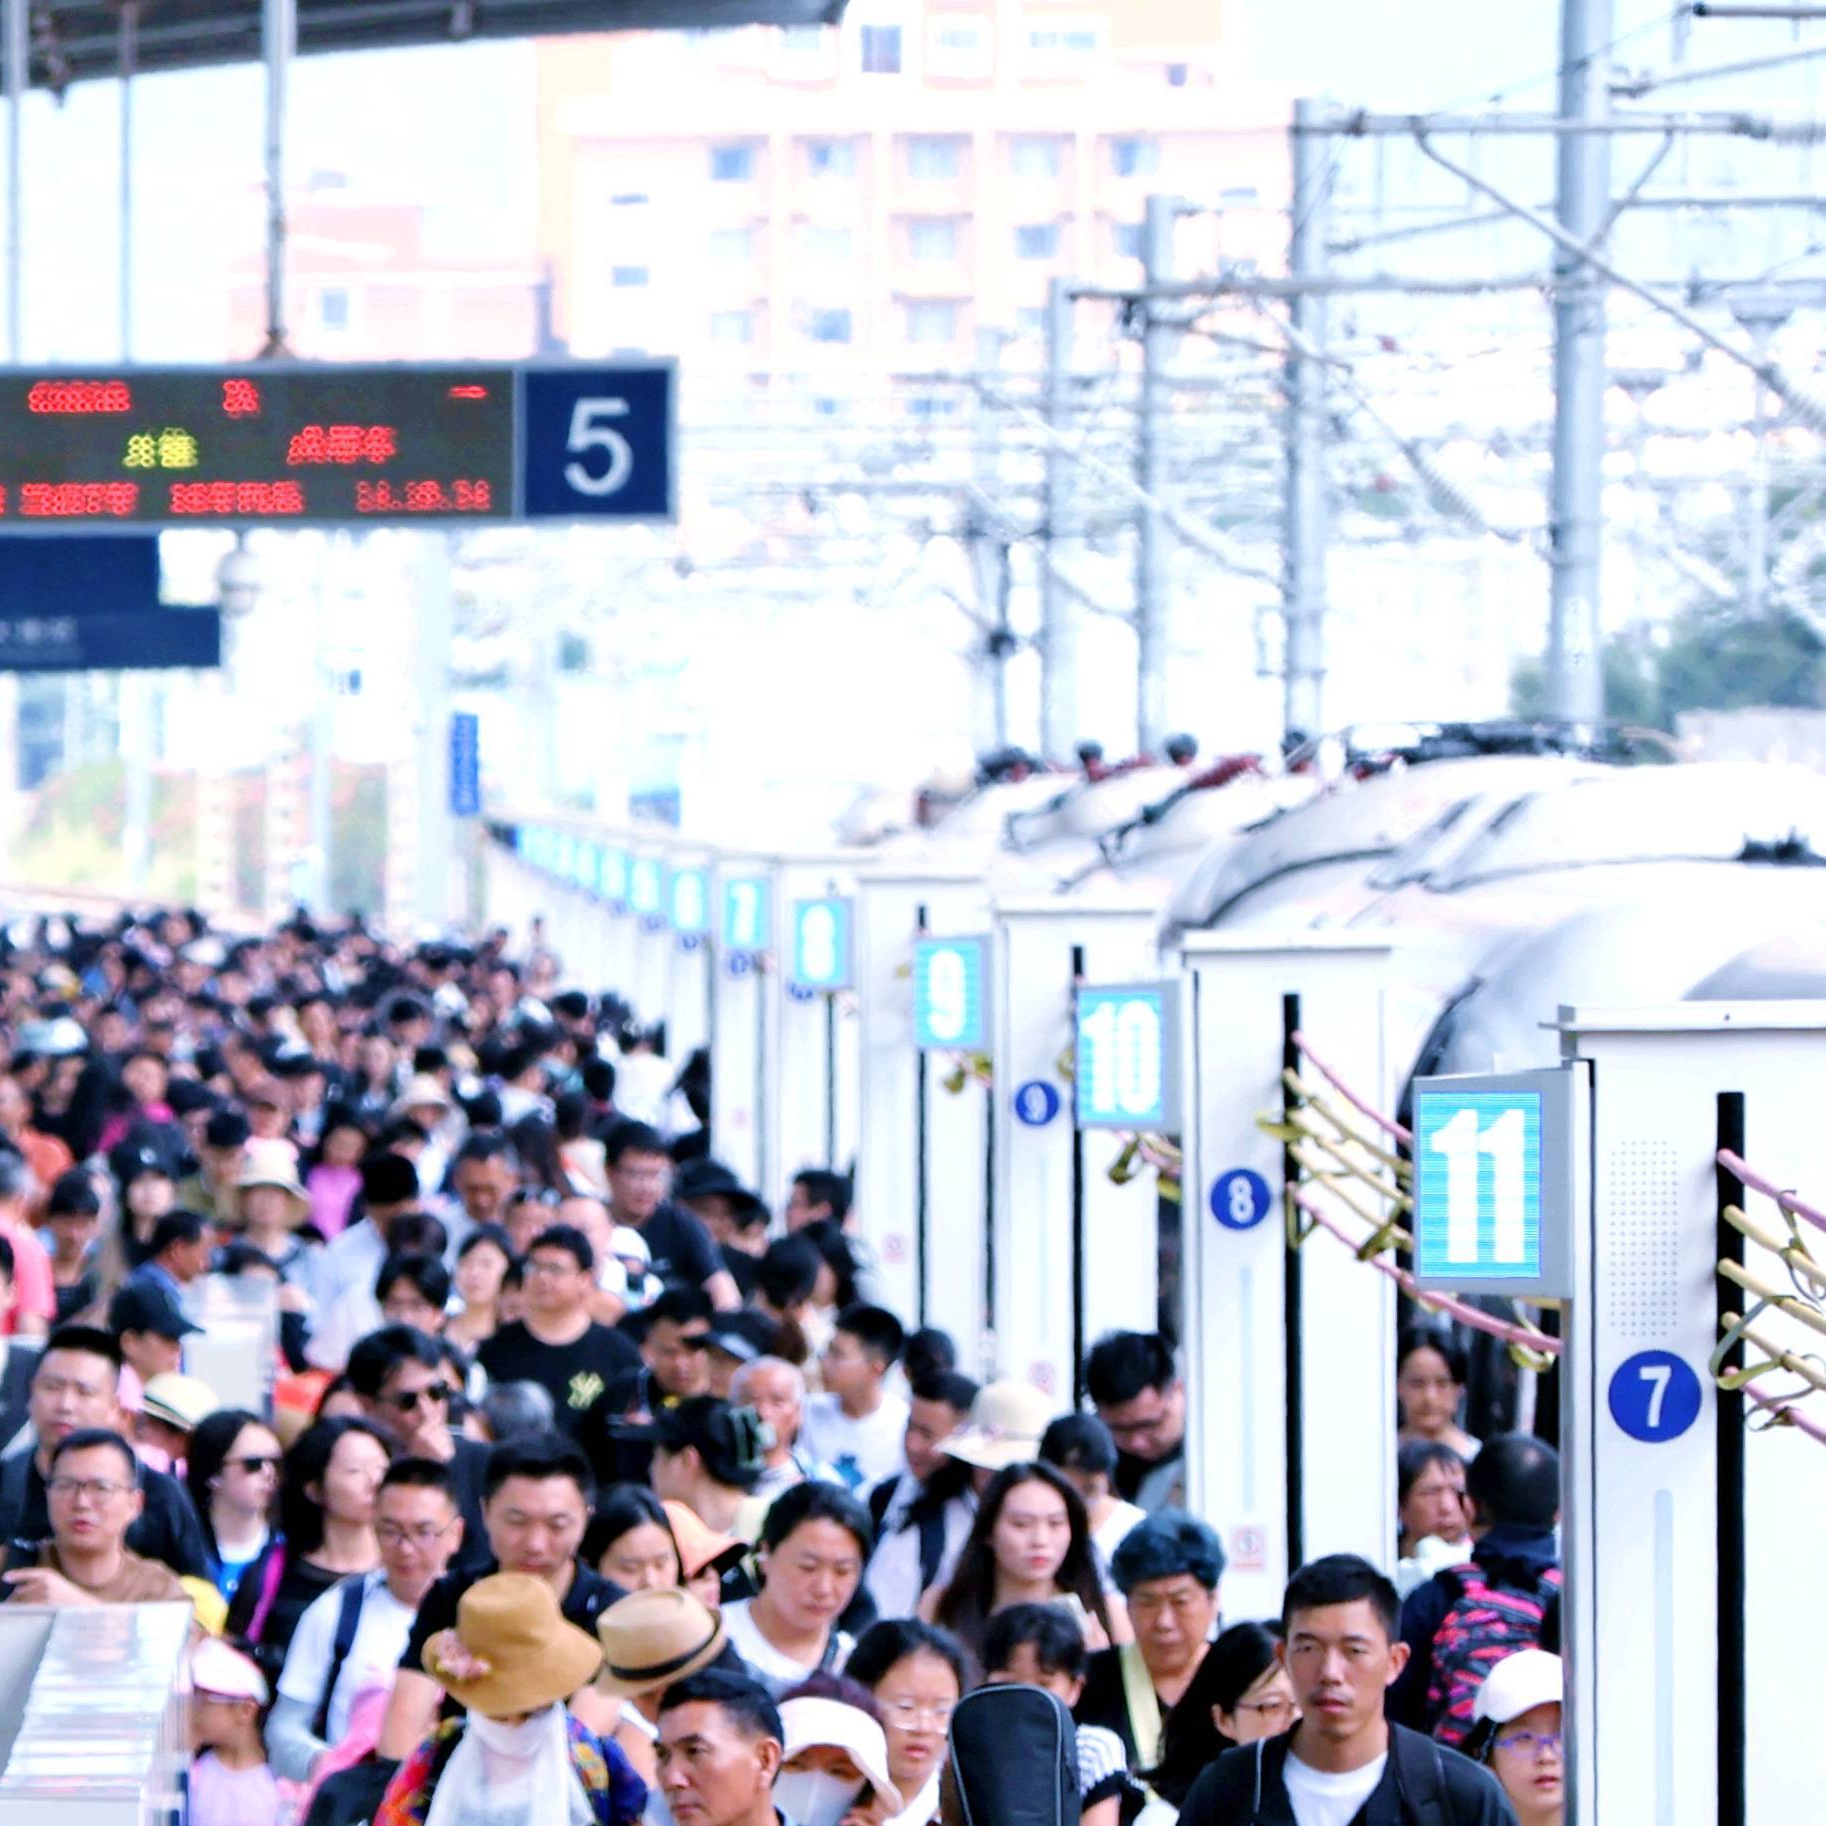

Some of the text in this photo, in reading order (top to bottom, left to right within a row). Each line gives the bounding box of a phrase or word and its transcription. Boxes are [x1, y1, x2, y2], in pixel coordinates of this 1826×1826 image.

[563, 396, 634, 496] 5
[799, 904, 837, 984] 8
[926, 949, 968, 1040] 9
[1080, 1000, 1163, 1118] 10
[1228, 1179, 1255, 1223] 8
[1431, 1108, 1526, 1264] 11
[1638, 1365, 1674, 1428] 7
